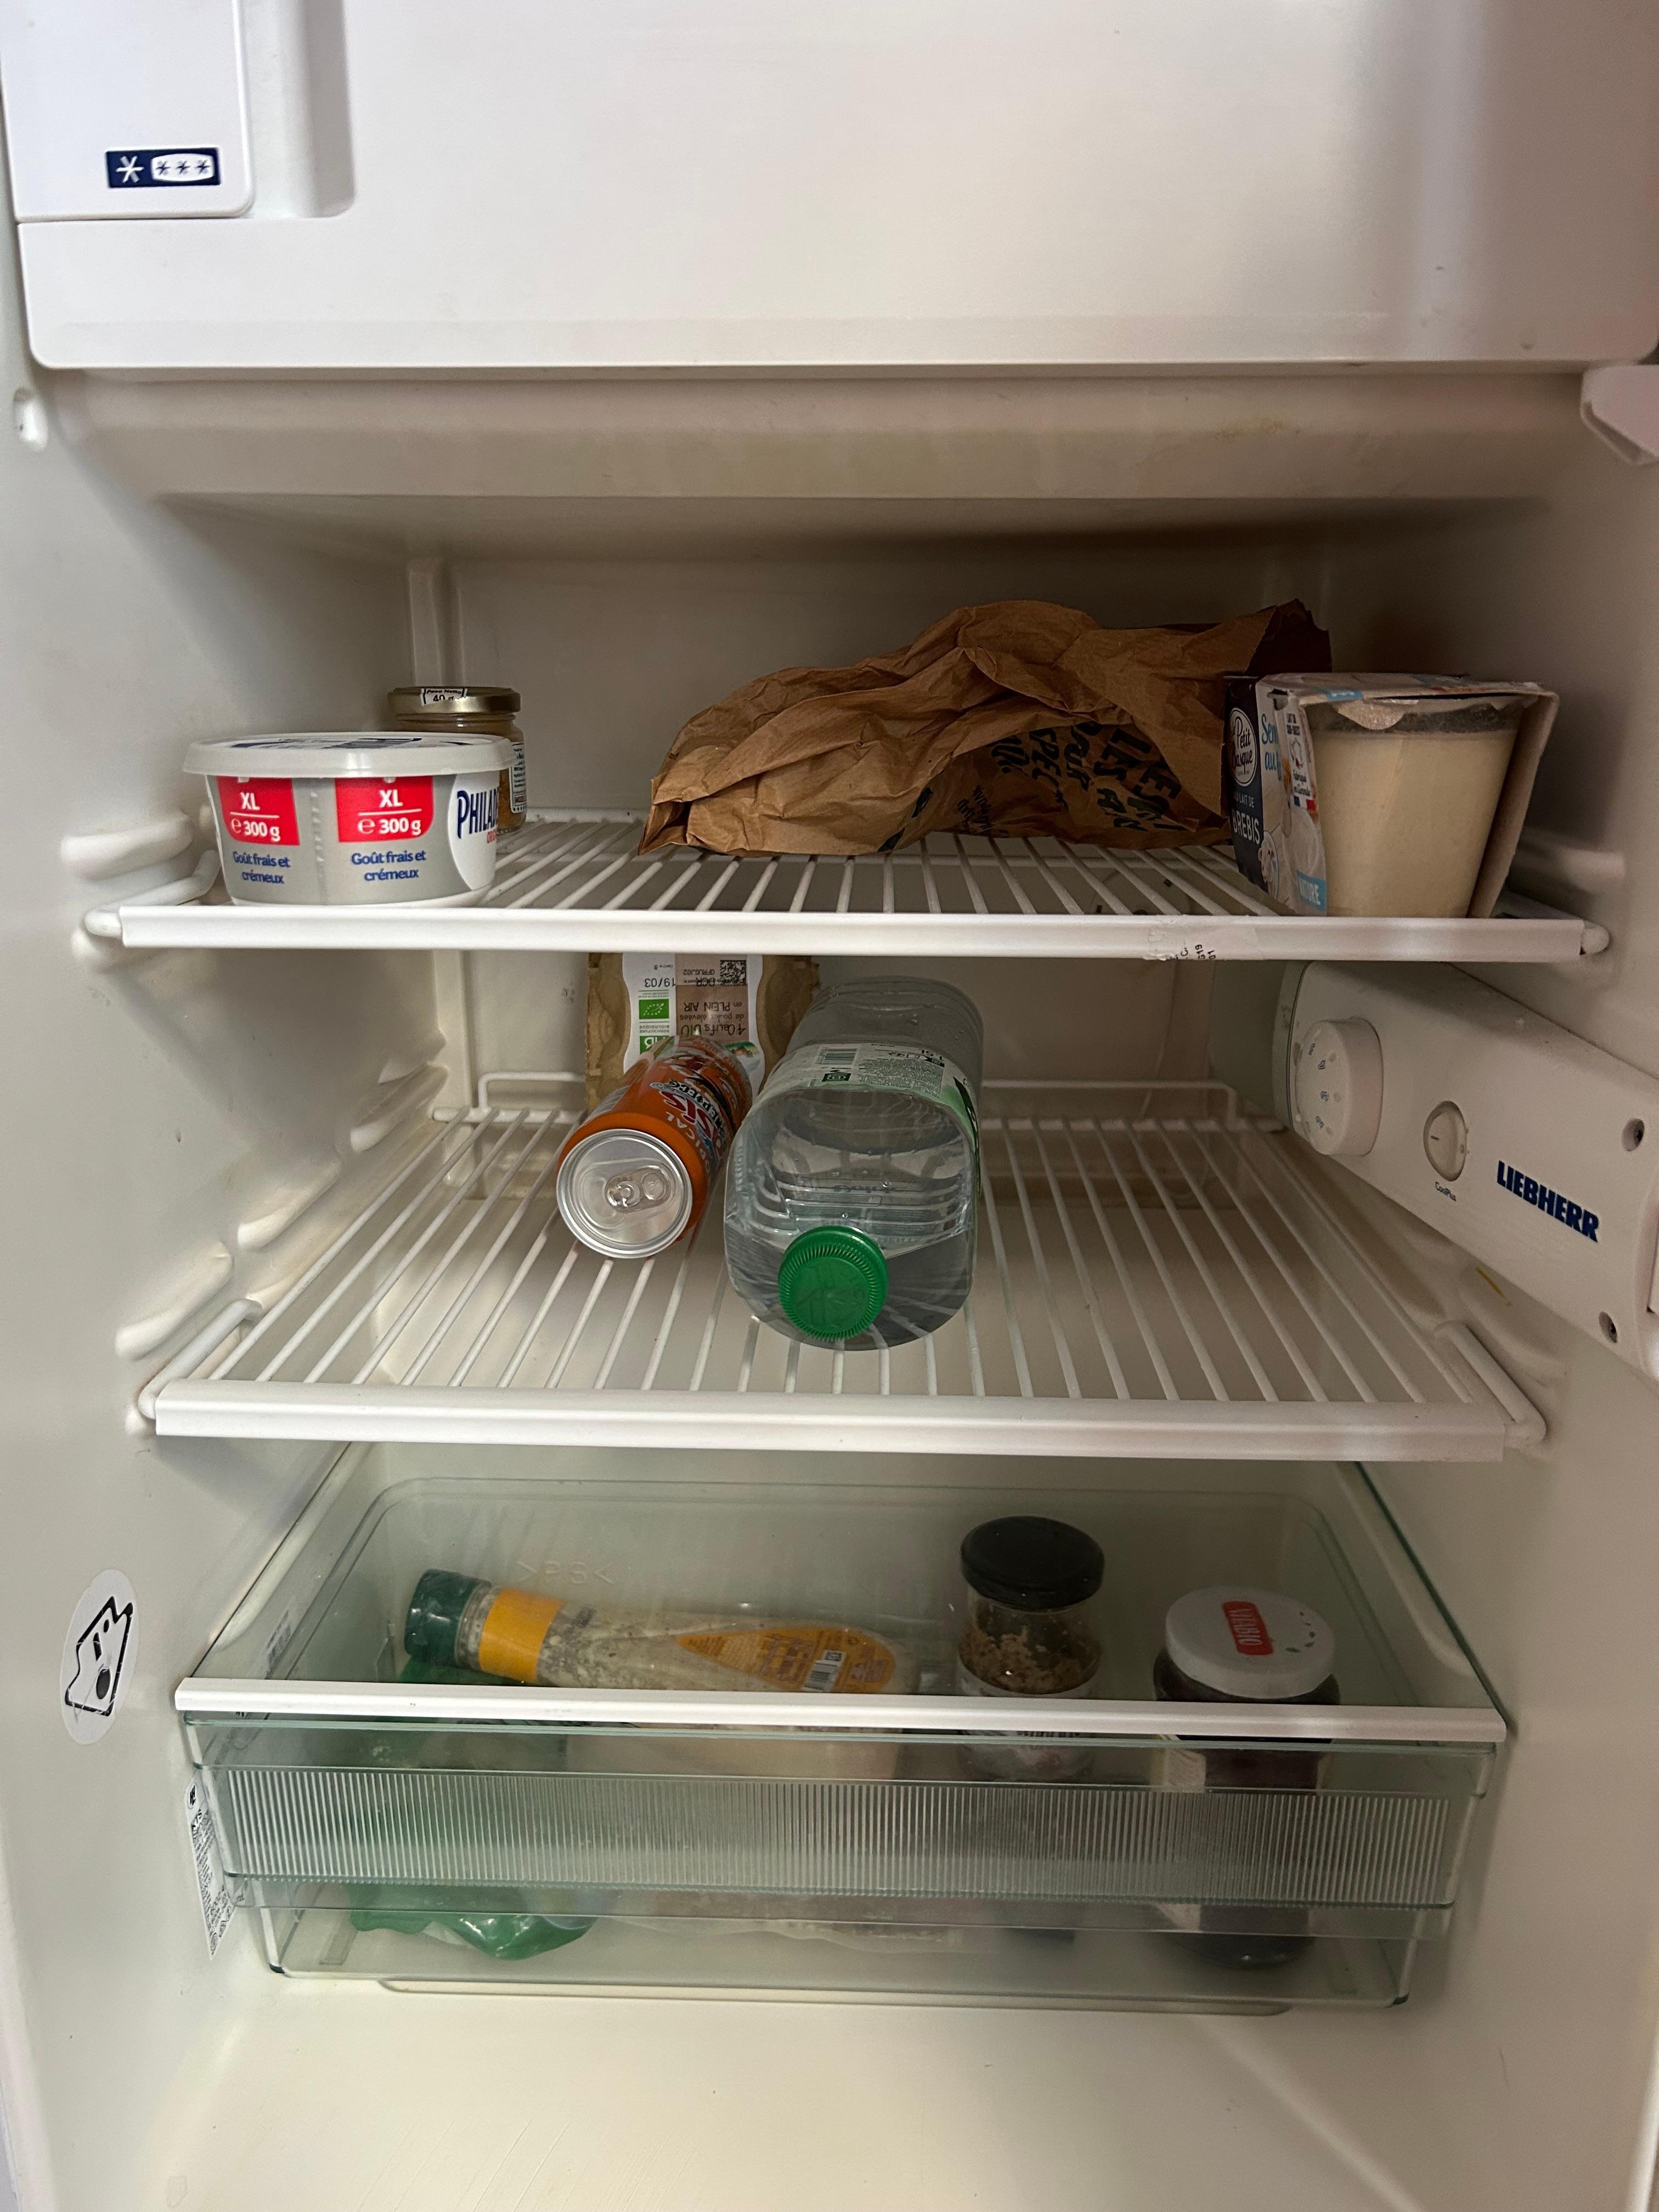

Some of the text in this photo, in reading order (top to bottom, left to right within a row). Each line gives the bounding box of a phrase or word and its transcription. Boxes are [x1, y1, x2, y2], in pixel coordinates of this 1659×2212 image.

[1235, 716, 1251, 749] Petit
[1233, 749, 1253, 775] asque
[240, 792, 261, 810] XL
[379, 789, 404, 808] XL
[243, 821, 268, 837] 300
[270, 826, 281, 842] g
[379, 817, 409, 834] 300
[411, 819, 421, 836] g
[1232, 807, 1260, 845] BREBIS
[233, 851, 291, 867] Goût frais et
[351, 850, 427, 865] Goût frais et
[242, 870, 285, 884] crémeux
[364, 868, 419, 881] crémeux
[645, 978, 676, 988] 19/03
[684, 1001, 699, 1012] AIR
[704, 1002, 731, 1012] PLEIN
[737, 1024, 746, 1035] 4
[1497, 1160, 1600, 1243] LIEBHERR
